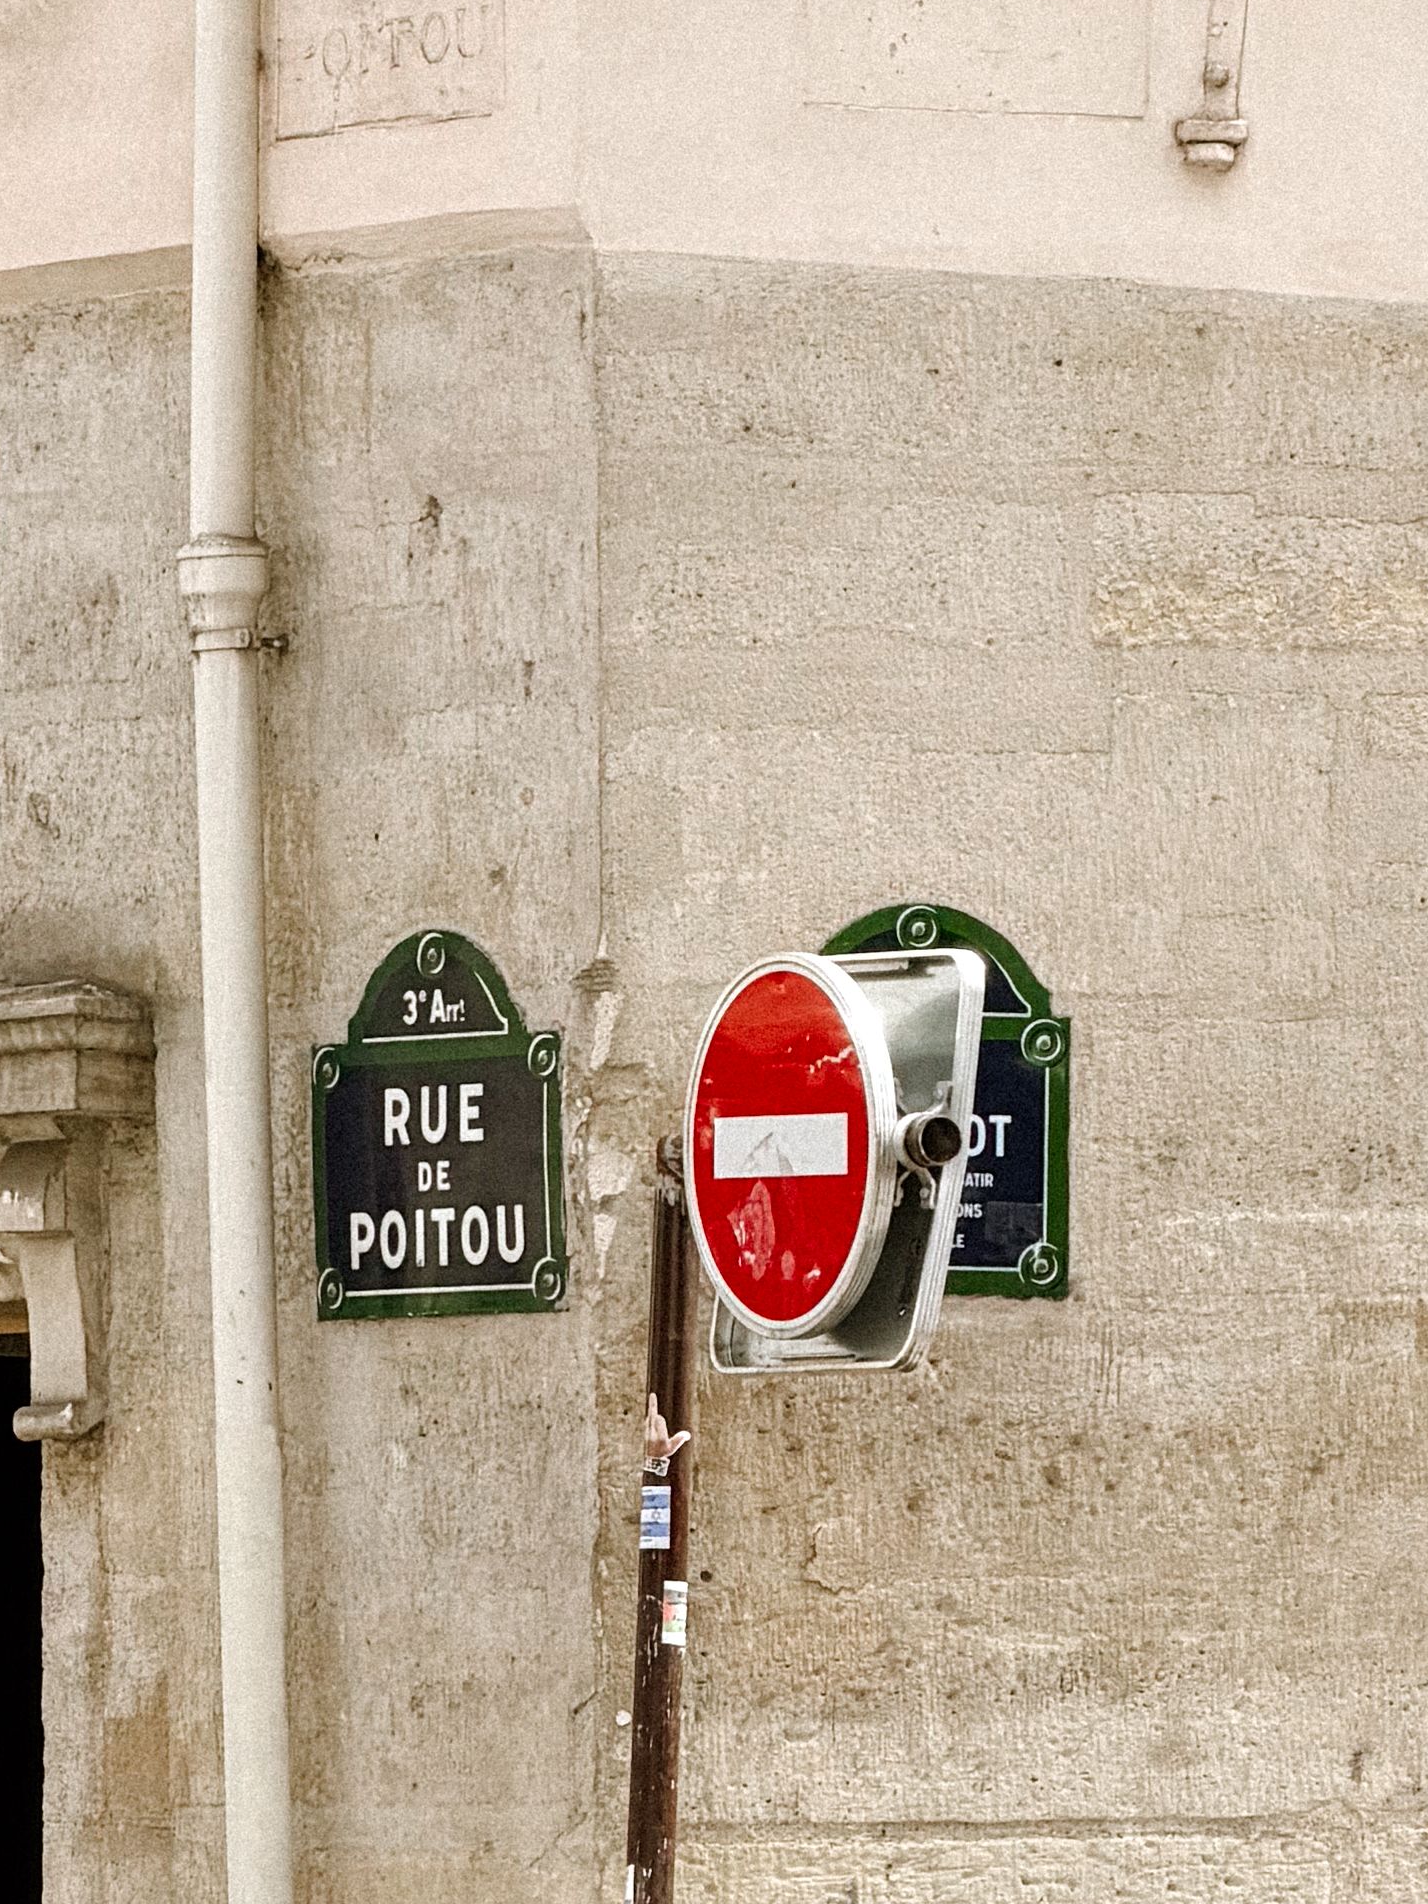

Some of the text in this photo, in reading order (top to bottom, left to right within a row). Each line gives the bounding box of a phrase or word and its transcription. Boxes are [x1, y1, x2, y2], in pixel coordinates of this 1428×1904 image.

[384, 1083, 484, 1147] RUE
[418, 1160, 451, 1192] DE
[350, 1204, 525, 1270] POITOU
